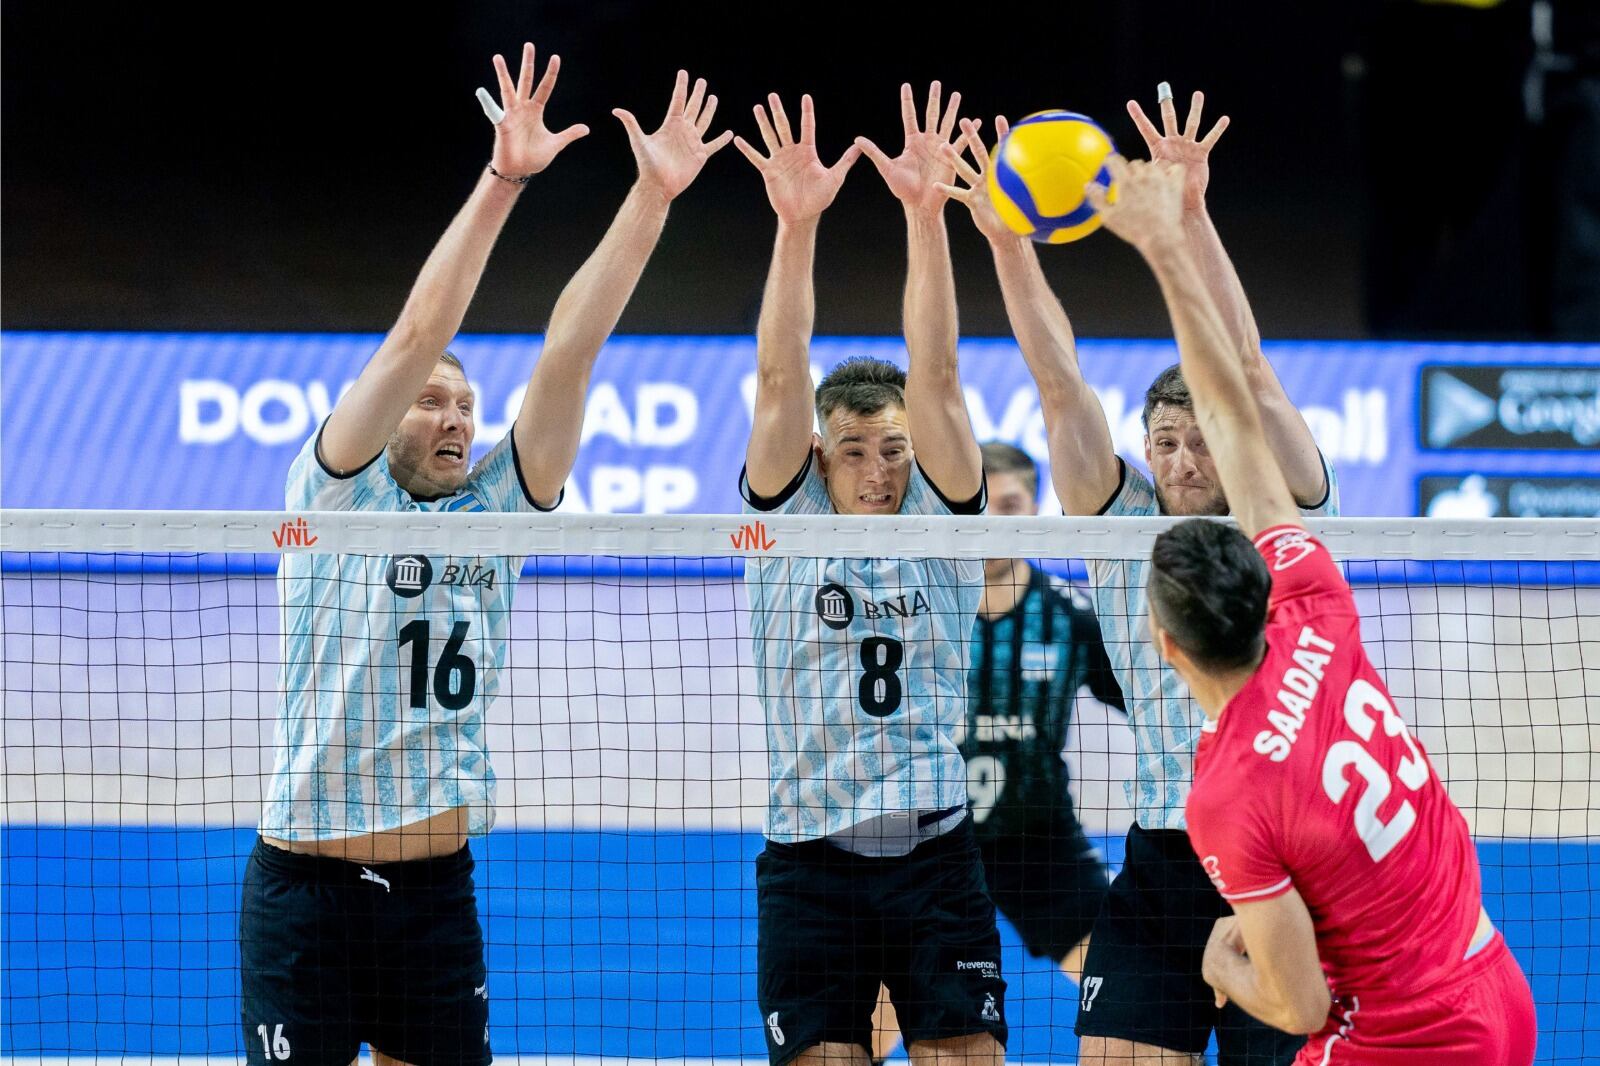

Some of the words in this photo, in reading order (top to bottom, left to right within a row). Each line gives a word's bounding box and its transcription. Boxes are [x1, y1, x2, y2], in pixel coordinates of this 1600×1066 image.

[272, 517, 318, 548] VNL
[730, 520, 777, 550] VNL
[439, 565, 495, 590] BNA
[862, 590, 930, 619] BNA
[398, 620, 476, 711] 16
[858, 636, 903, 718] 8
[1253, 626, 1336, 762] SAADAT
[966, 755, 1006, 823] 9
[1322, 679, 1430, 864] 23
[1081, 976, 1103, 1012] 17
[257, 1023, 291, 1060] 16
[767, 1011, 785, 1046] 8
